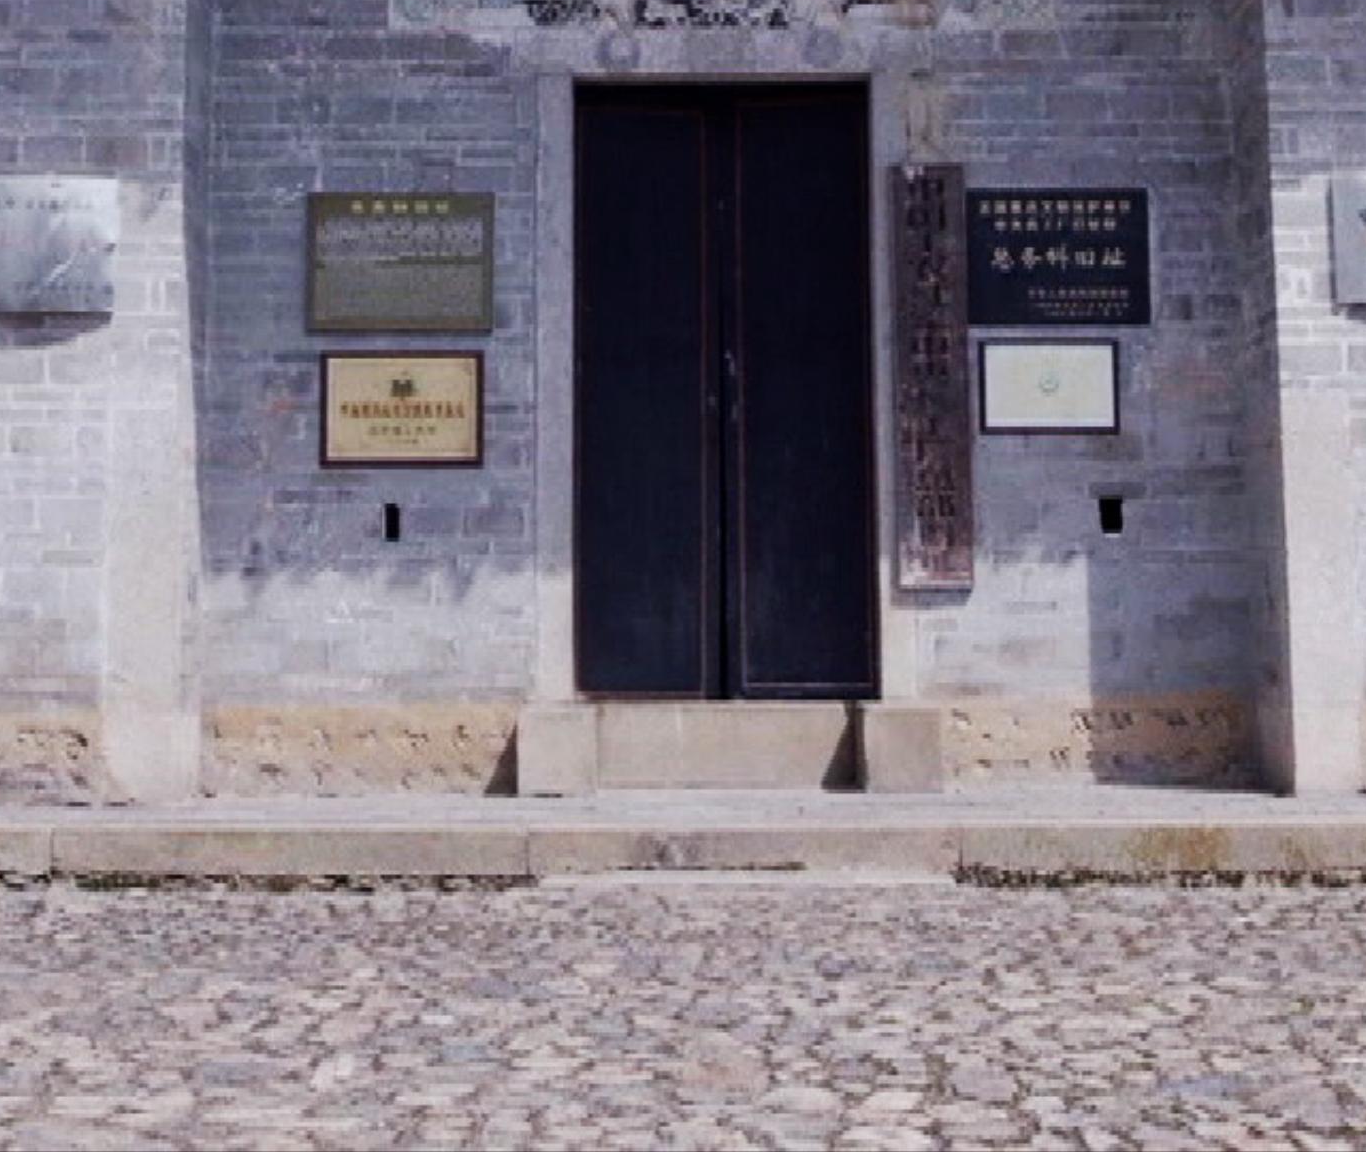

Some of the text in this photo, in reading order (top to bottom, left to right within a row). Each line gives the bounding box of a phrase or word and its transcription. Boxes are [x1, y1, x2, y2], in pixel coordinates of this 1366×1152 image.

[991, 243, 1127, 273] 总务科旧址
